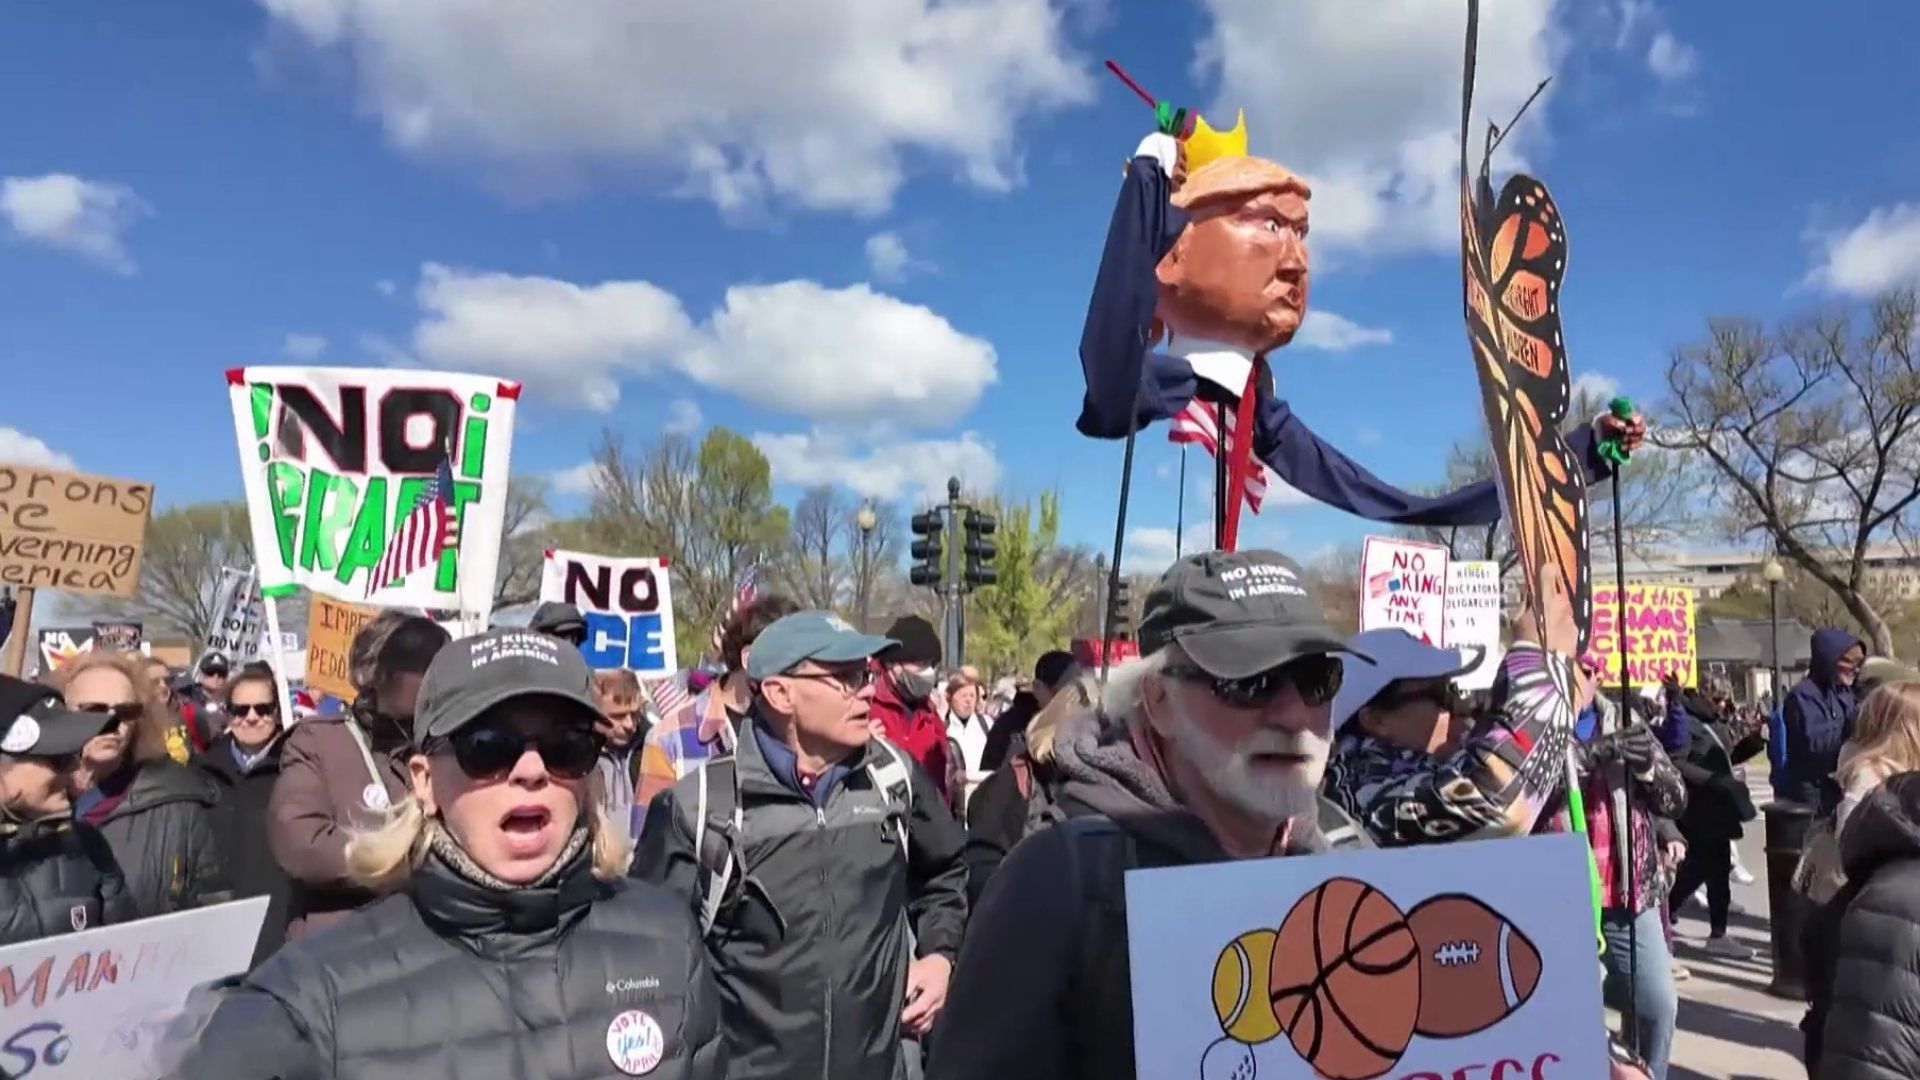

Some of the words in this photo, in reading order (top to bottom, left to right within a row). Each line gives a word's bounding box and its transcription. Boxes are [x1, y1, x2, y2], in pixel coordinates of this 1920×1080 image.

[1392, 550, 1425, 572] NO
[1220, 567, 1248, 583] NO
[1402, 572, 1442, 595] KING
[564, 560, 660, 613] NO
[1228, 587, 1246, 601] IN
[1248, 583, 1307, 597] AMERICA
[1389, 593, 1421, 610] ANY
[1650, 588, 1688, 607] this
[1383, 606, 1425, 627] TIME
[470, 637, 499, 655] NO
[501, 633, 559, 651] KINGS
[471, 658, 488, 670] IN
[490, 648, 560, 667] AMERICA
